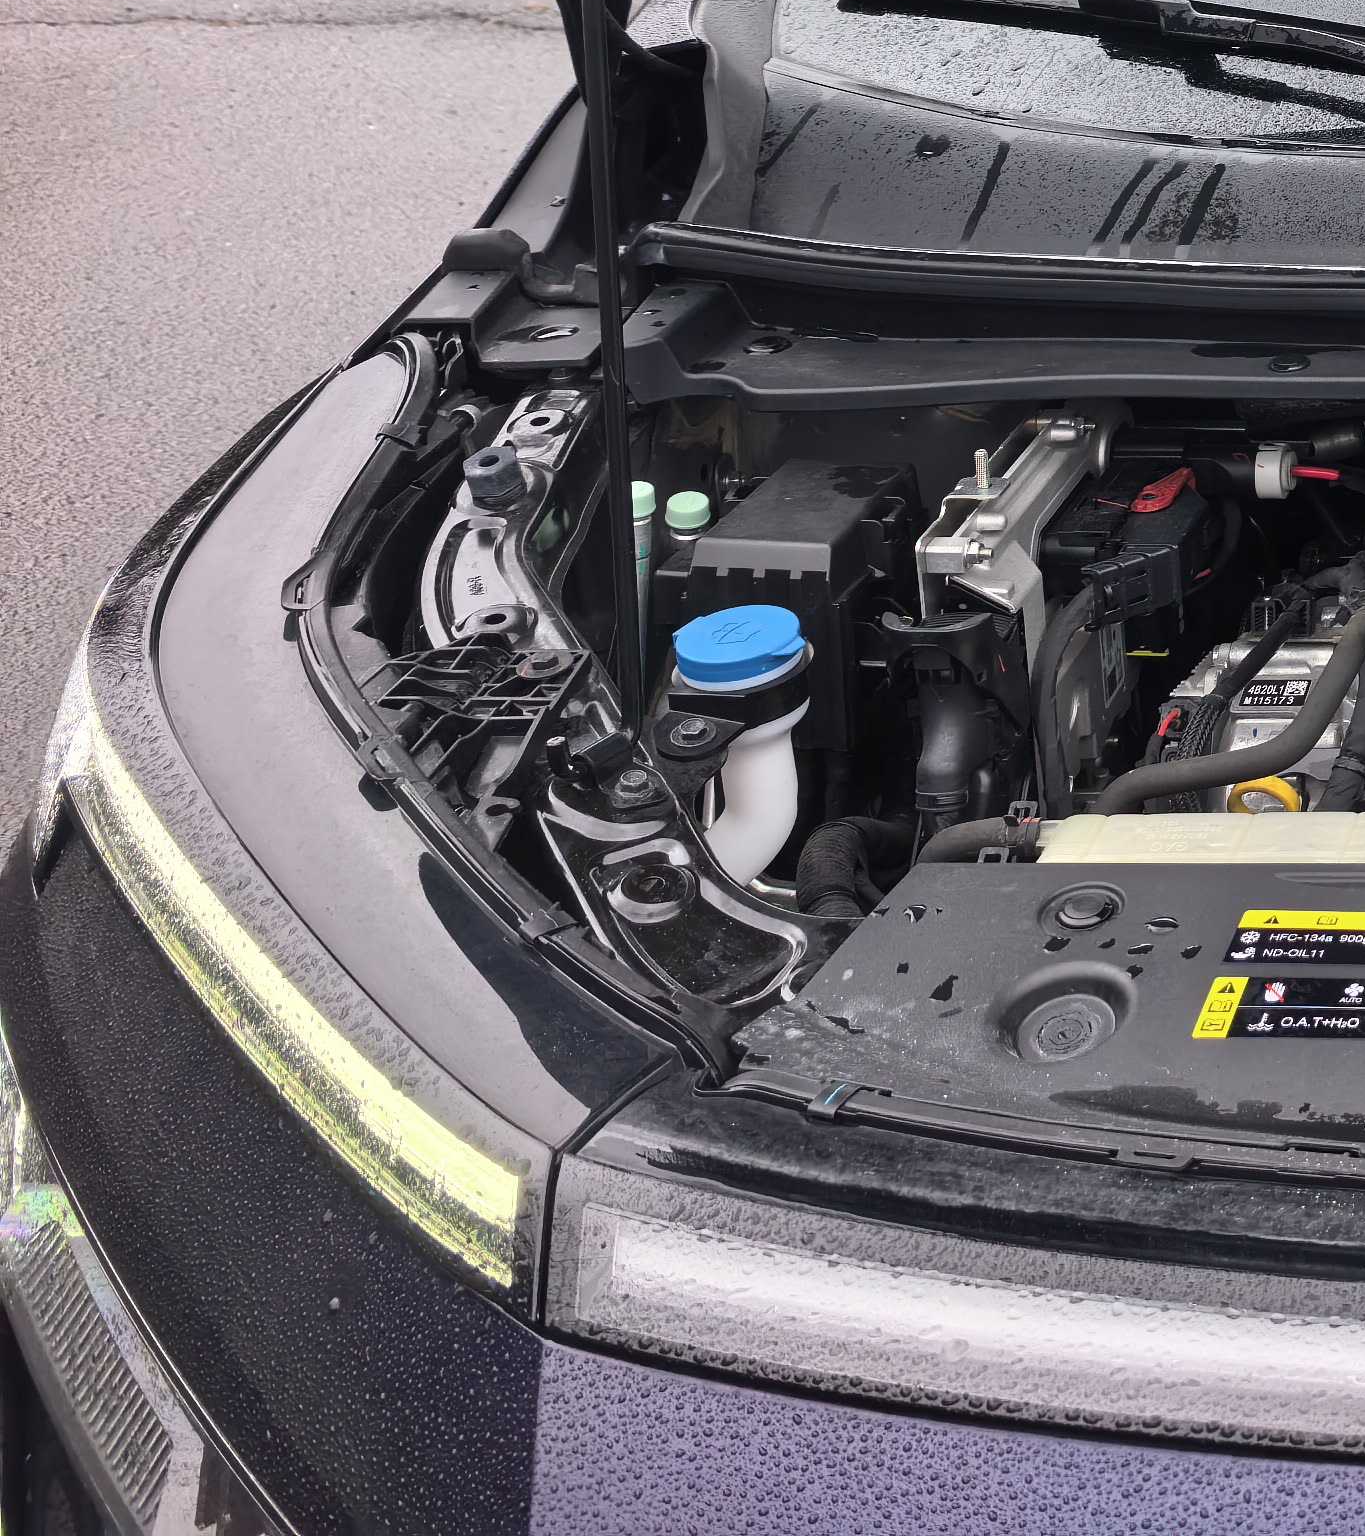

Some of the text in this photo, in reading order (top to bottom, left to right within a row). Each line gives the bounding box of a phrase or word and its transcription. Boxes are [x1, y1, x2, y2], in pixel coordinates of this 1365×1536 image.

[1247, 684, 1285, 695] 4B20L1
[1243, 696, 1295, 705] M115173
[1262, 948, 1325, 958] ND-OIL11
